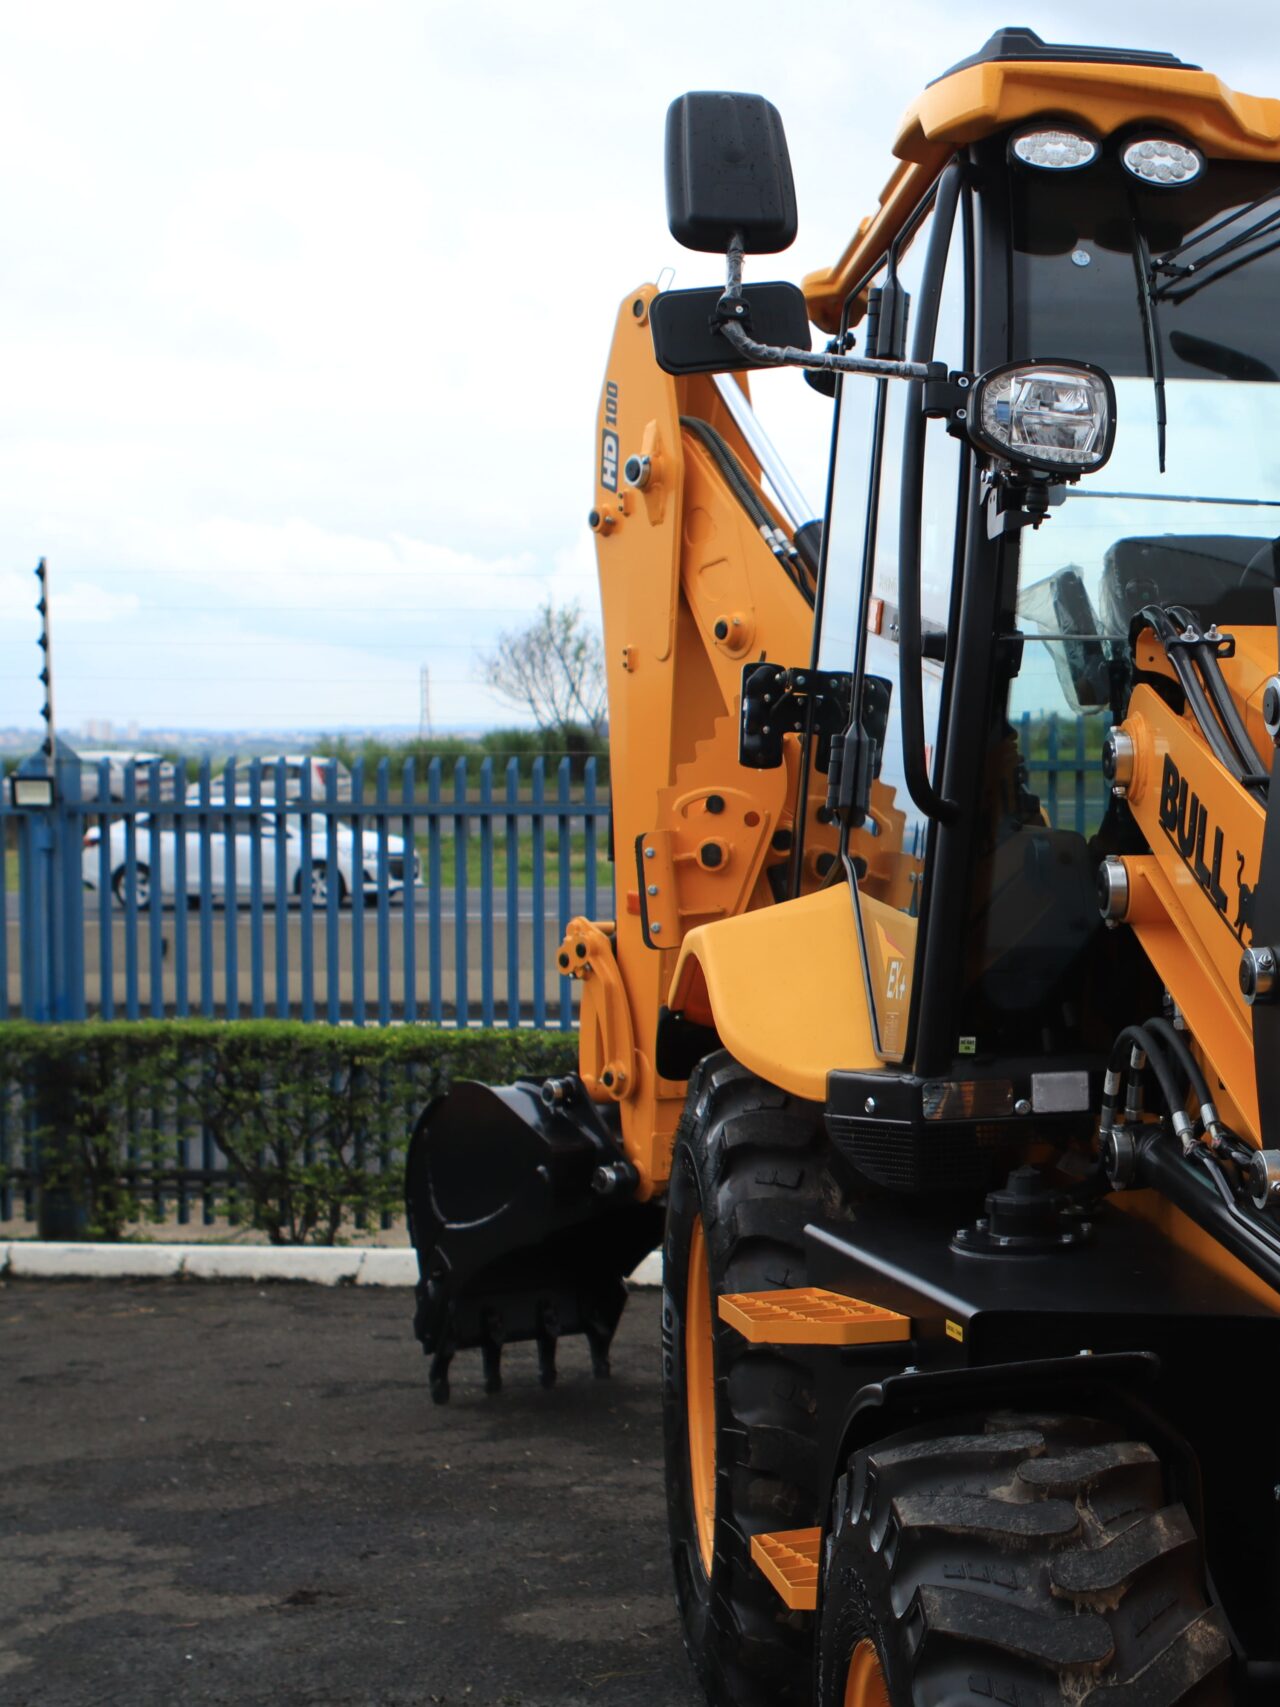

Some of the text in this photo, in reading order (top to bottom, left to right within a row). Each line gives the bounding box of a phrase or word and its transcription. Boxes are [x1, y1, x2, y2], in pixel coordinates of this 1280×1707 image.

[602, 381, 618, 487] HD 100
[1160, 752, 1229, 913] BULL
